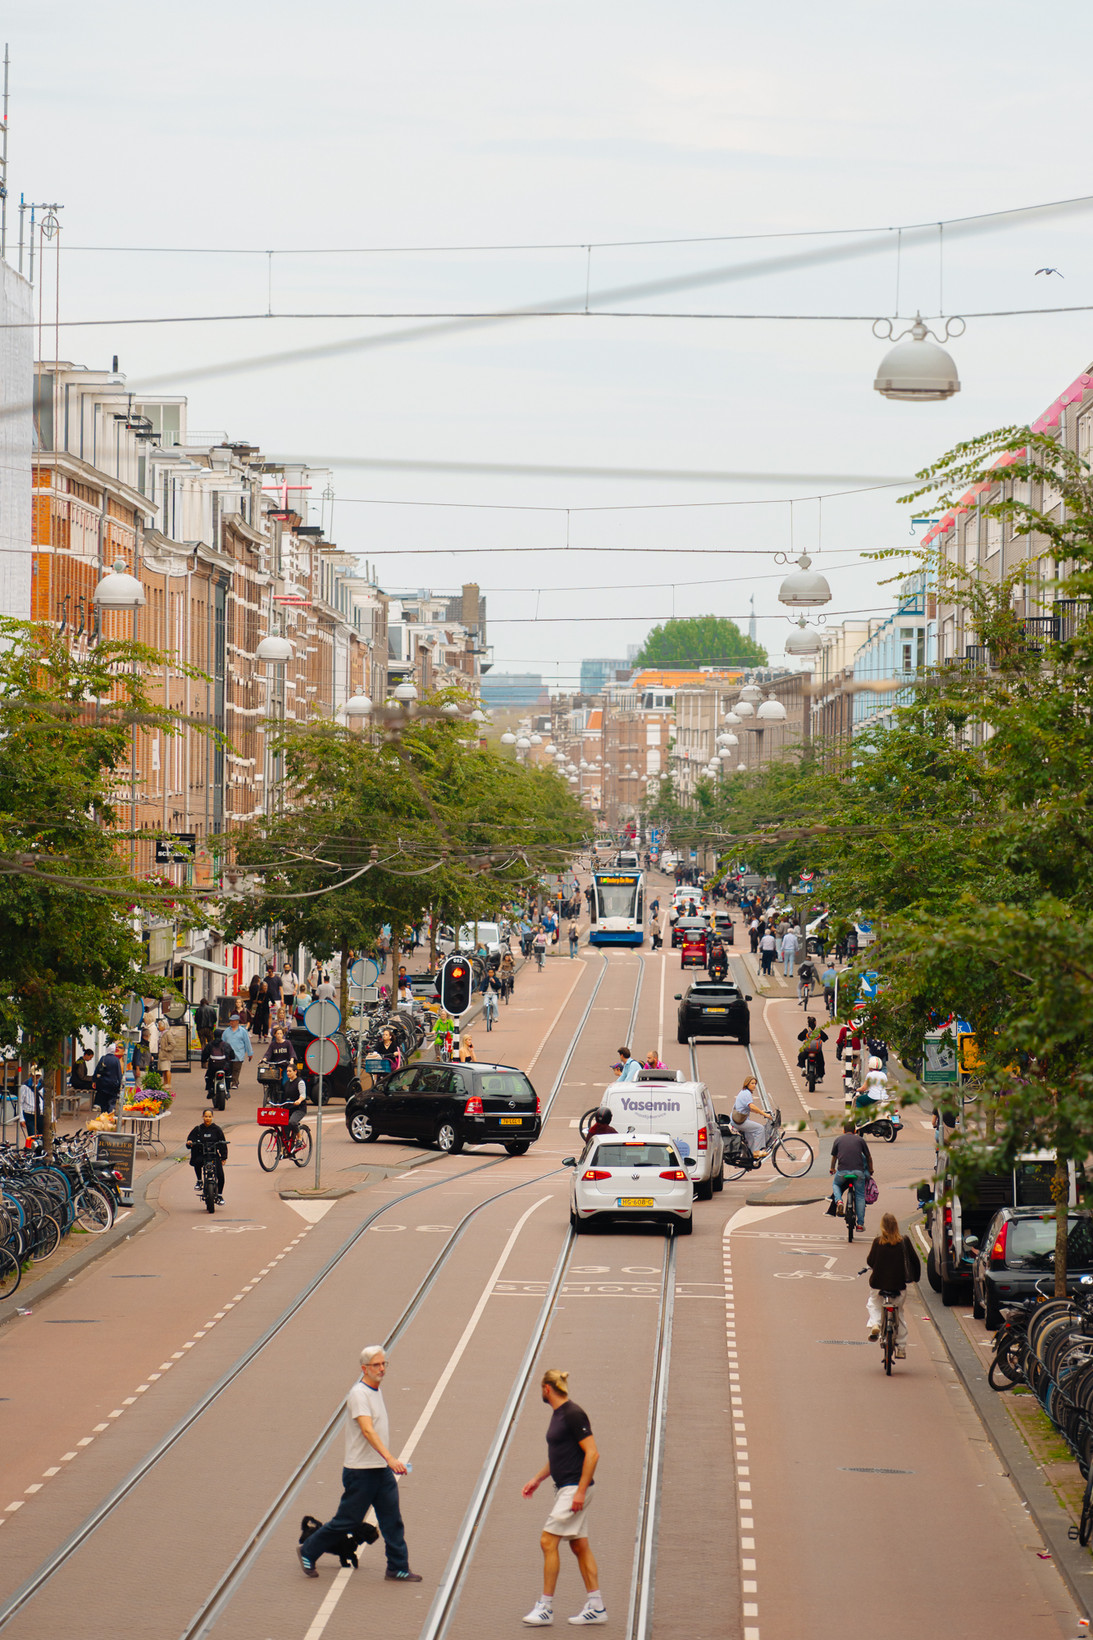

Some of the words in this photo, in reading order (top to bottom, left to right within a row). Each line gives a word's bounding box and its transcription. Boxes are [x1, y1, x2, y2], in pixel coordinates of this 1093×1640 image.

[620, 1097, 681, 1112] Yasemin
[568, 1265, 662, 1275] 30
[495, 1284, 694, 1293] SCHOOL
